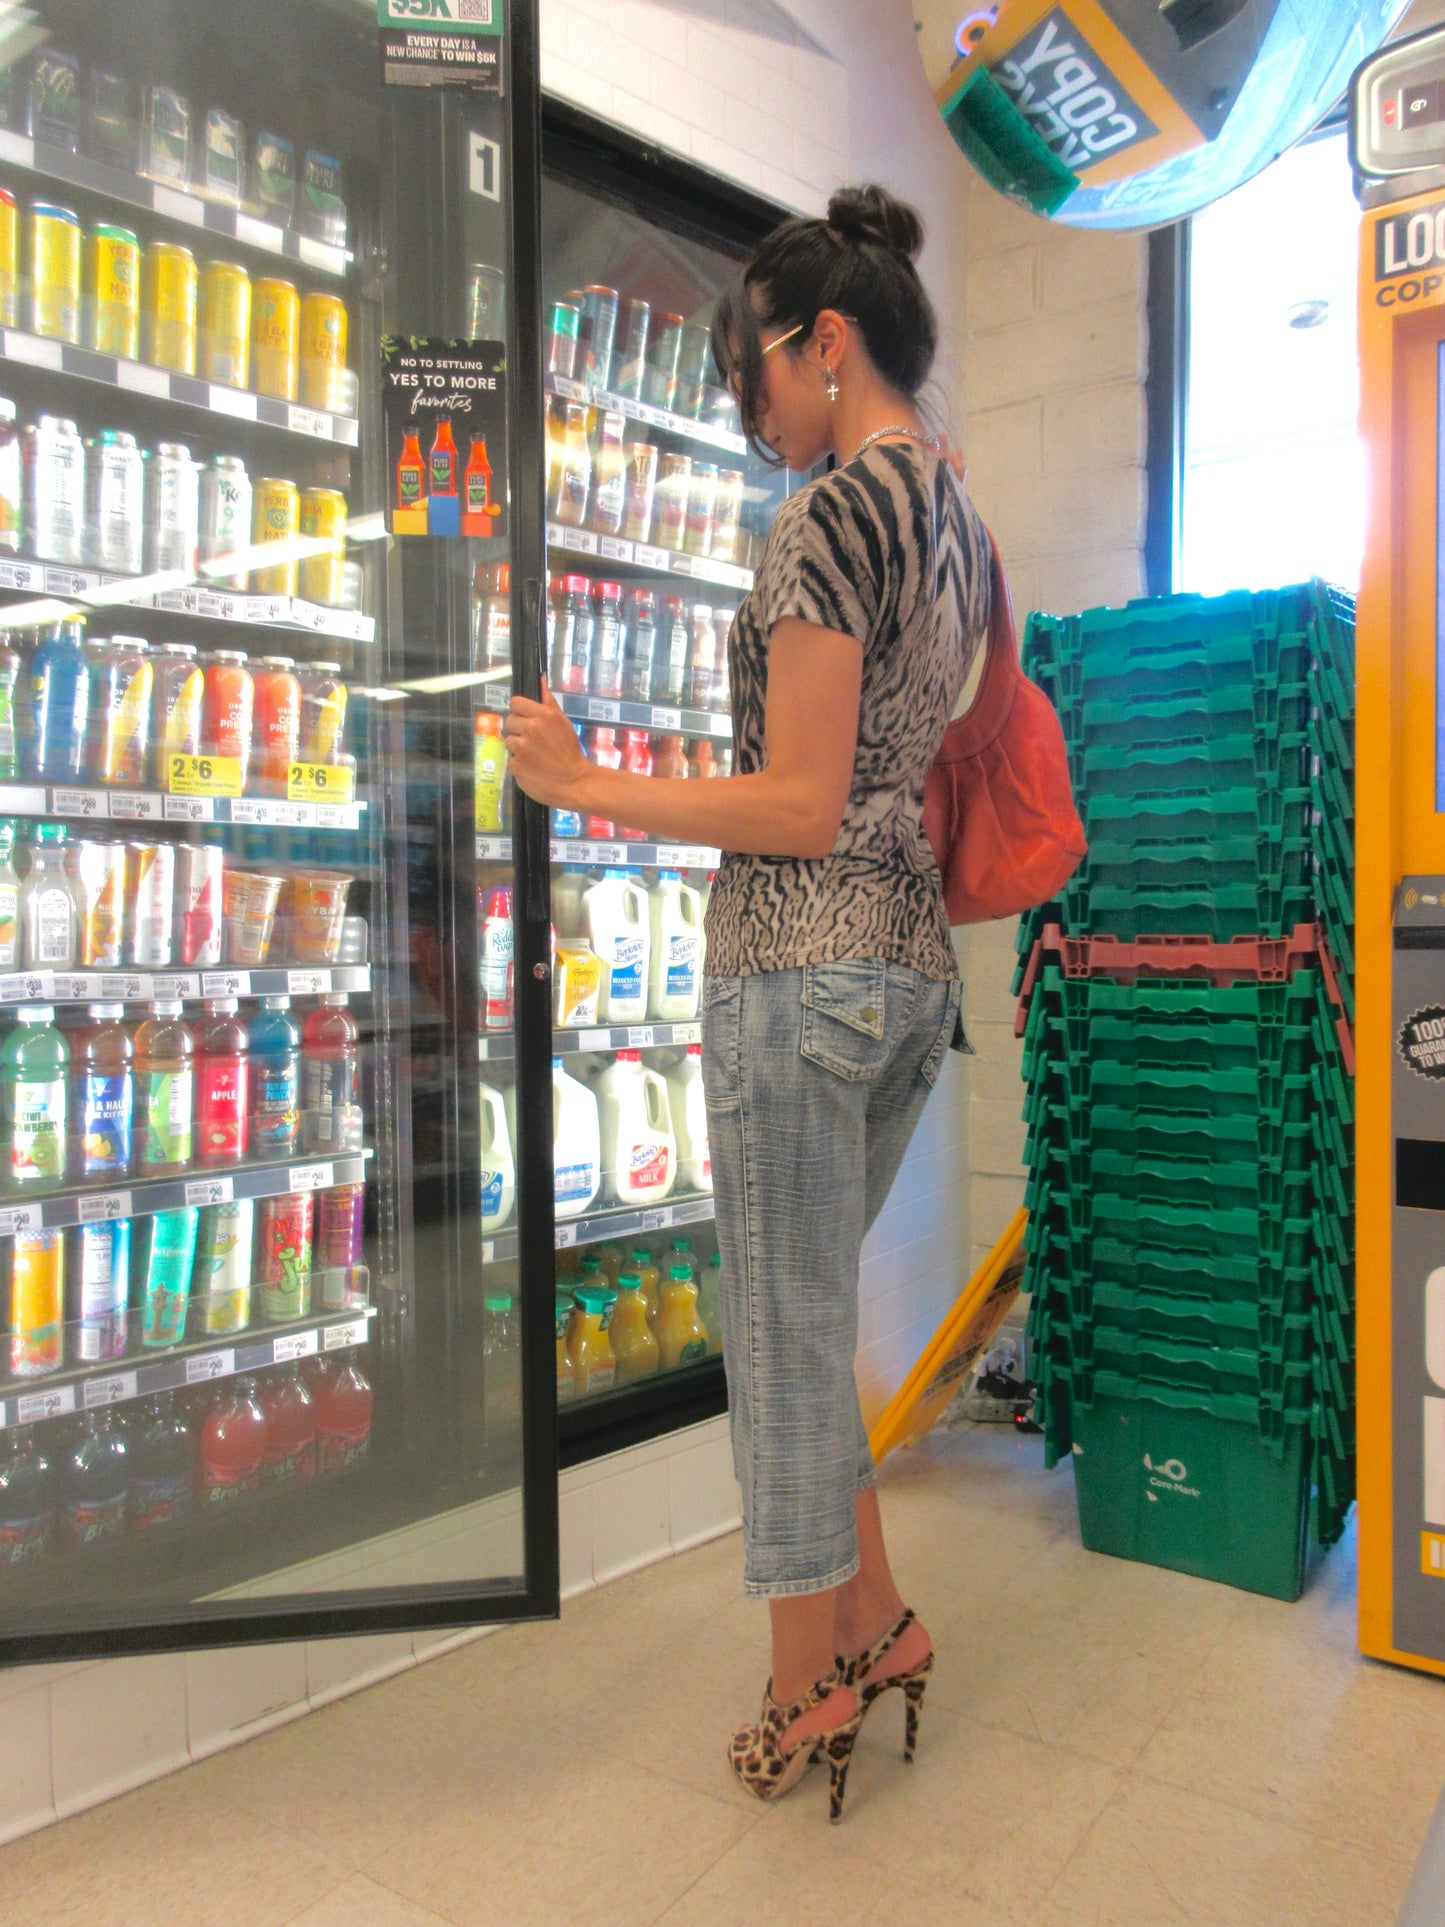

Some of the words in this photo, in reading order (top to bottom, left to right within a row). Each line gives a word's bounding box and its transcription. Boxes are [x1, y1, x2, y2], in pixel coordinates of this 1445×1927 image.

[407, 35, 439, 48] EVERY
[441, 37, 460, 49] DAY
[462, 39, 470, 50] IS
[471, 40, 477, 51] A
[386, 45, 405, 57] NEW
[406, 46, 438, 60] CHANCE
[441, 50, 453, 60] TO
[455, 51, 475, 62] WIN
[476, 52, 496, 64] $5K
[476, 144, 493, 193] 1
[1376, 274, 1445, 308] COP
[401, 358, 417, 367] NO
[420, 359, 433, 368] TO
[436, 360, 483, 370] SETTLING
[390, 373, 418, 386] YES
[424, 375, 445, 388] TO
[451, 376, 497, 390] MORE
[411, 389, 473, 415] favorites
[173, 758, 185, 777] 2
[292, 767, 302, 785] 2
[1419, 1055, 1434, 1068] TO
[211, 1091, 236, 1100] APPLE
[639, 1173, 659, 1184] MILK
[1150, 1477, 1201, 1497] Core-Mark
